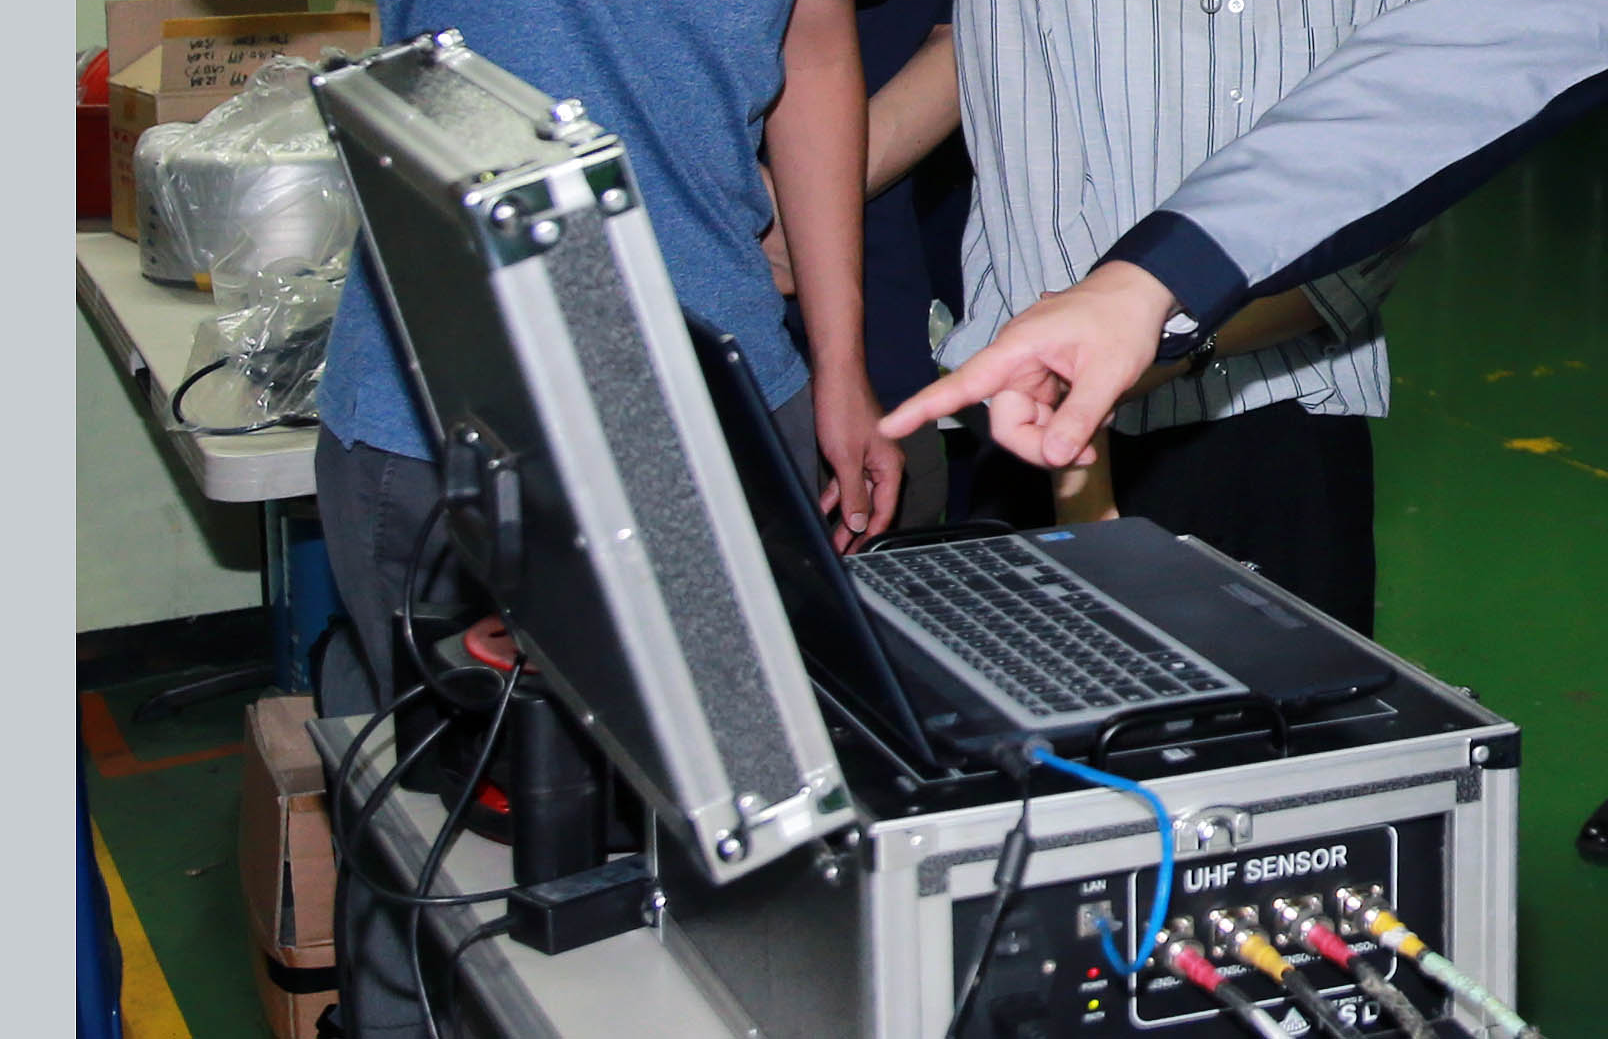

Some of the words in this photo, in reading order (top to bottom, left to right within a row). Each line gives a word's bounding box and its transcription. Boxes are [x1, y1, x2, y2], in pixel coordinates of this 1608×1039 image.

[1183, 862, 1238, 894] UHF
[1243, 844, 1348, 885] SENSOR
[1081, 880, 1107, 894] LAN
